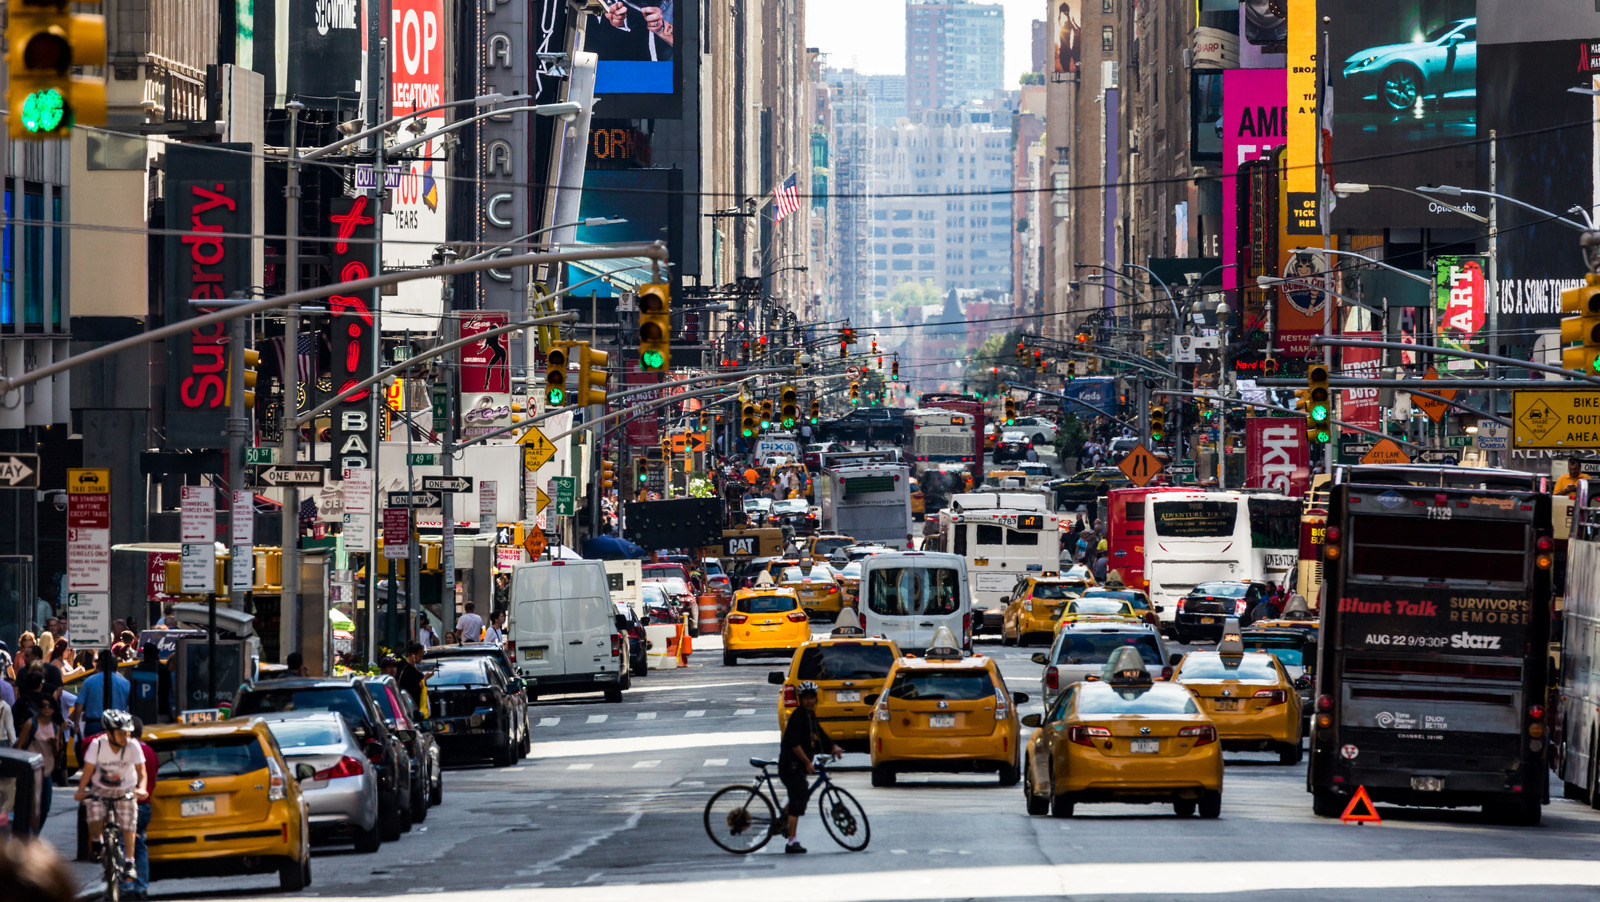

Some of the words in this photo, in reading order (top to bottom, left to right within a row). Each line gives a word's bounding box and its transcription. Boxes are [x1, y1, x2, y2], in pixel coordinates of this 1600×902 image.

[1196, 42, 1219, 52] SHARP
[358, 168, 400, 186] OUTONT
[395, 210, 418, 229] YEARS
[1450, 266, 1472, 332] ART
[1502, 279, 1514, 314] US
[1516, 279, 1522, 314] A
[1525, 279, 1549, 314] SONG
[1236, 360, 1258, 370] Hard
[1079, 391, 1101, 400] Keds
[1574, 397, 1600, 408] BIKE
[1568, 415, 1600, 424] ROUT
[248, 449, 258, 461] 50
[416, 455, 424, 464] 49
[1262, 424, 1299, 496] tkts
[269, 472, 289, 480] ONE
[294, 472, 315, 481] WAY
[345, 470, 350, 478] 3
[344, 514, 350, 523] 6
[1427, 507, 1452, 520] 71329
[1025, 517, 1035, 525] M7
[70, 529, 76, 540] 3
[183, 545, 189, 556] 6
[729, 539, 754, 554] CAT
[69, 594, 76, 606] 6
[1450, 597, 1530, 611] SURVIVOR'S
[1338, 598, 1392, 614] Blunt
[1396, 600, 1438, 616] Talk
[1450, 611, 1529, 625] REMORSE
[1366, 634, 1390, 645] AUG
[1392, 636, 1406, 645] 22
[1408, 637, 1449, 648] 9/9:30P
[1450, 631, 1501, 649] starz
